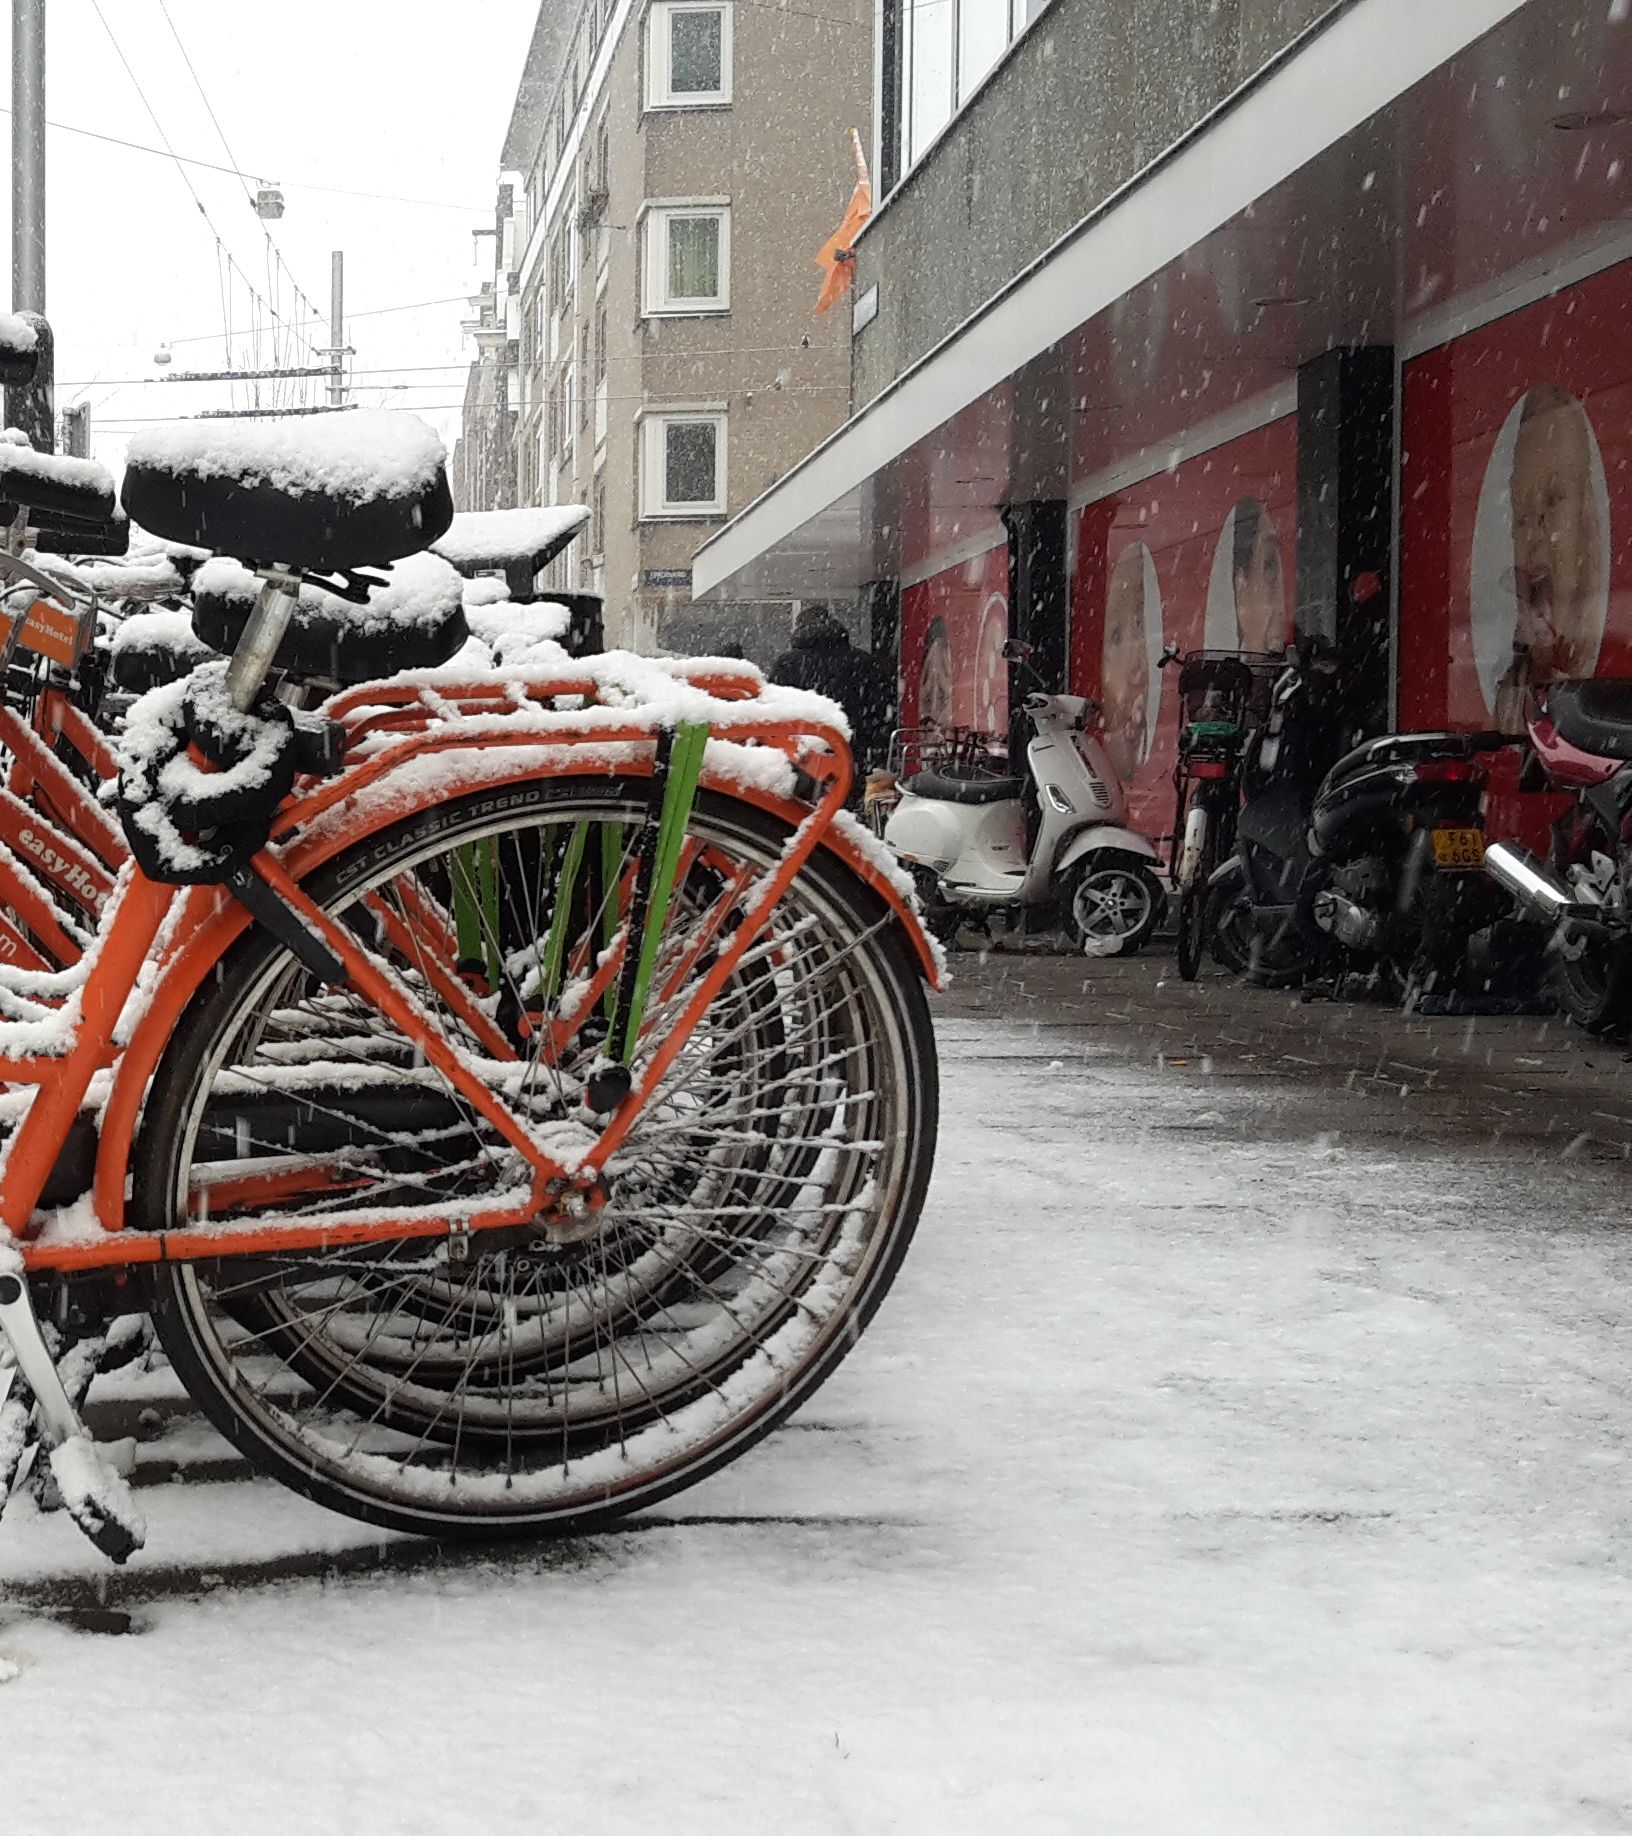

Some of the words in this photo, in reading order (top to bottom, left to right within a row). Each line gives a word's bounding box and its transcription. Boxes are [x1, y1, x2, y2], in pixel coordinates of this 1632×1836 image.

[335, 854, 368, 885] CST
[373, 810, 462, 861] CLASSIC
[468, 790, 540, 818] TREND
